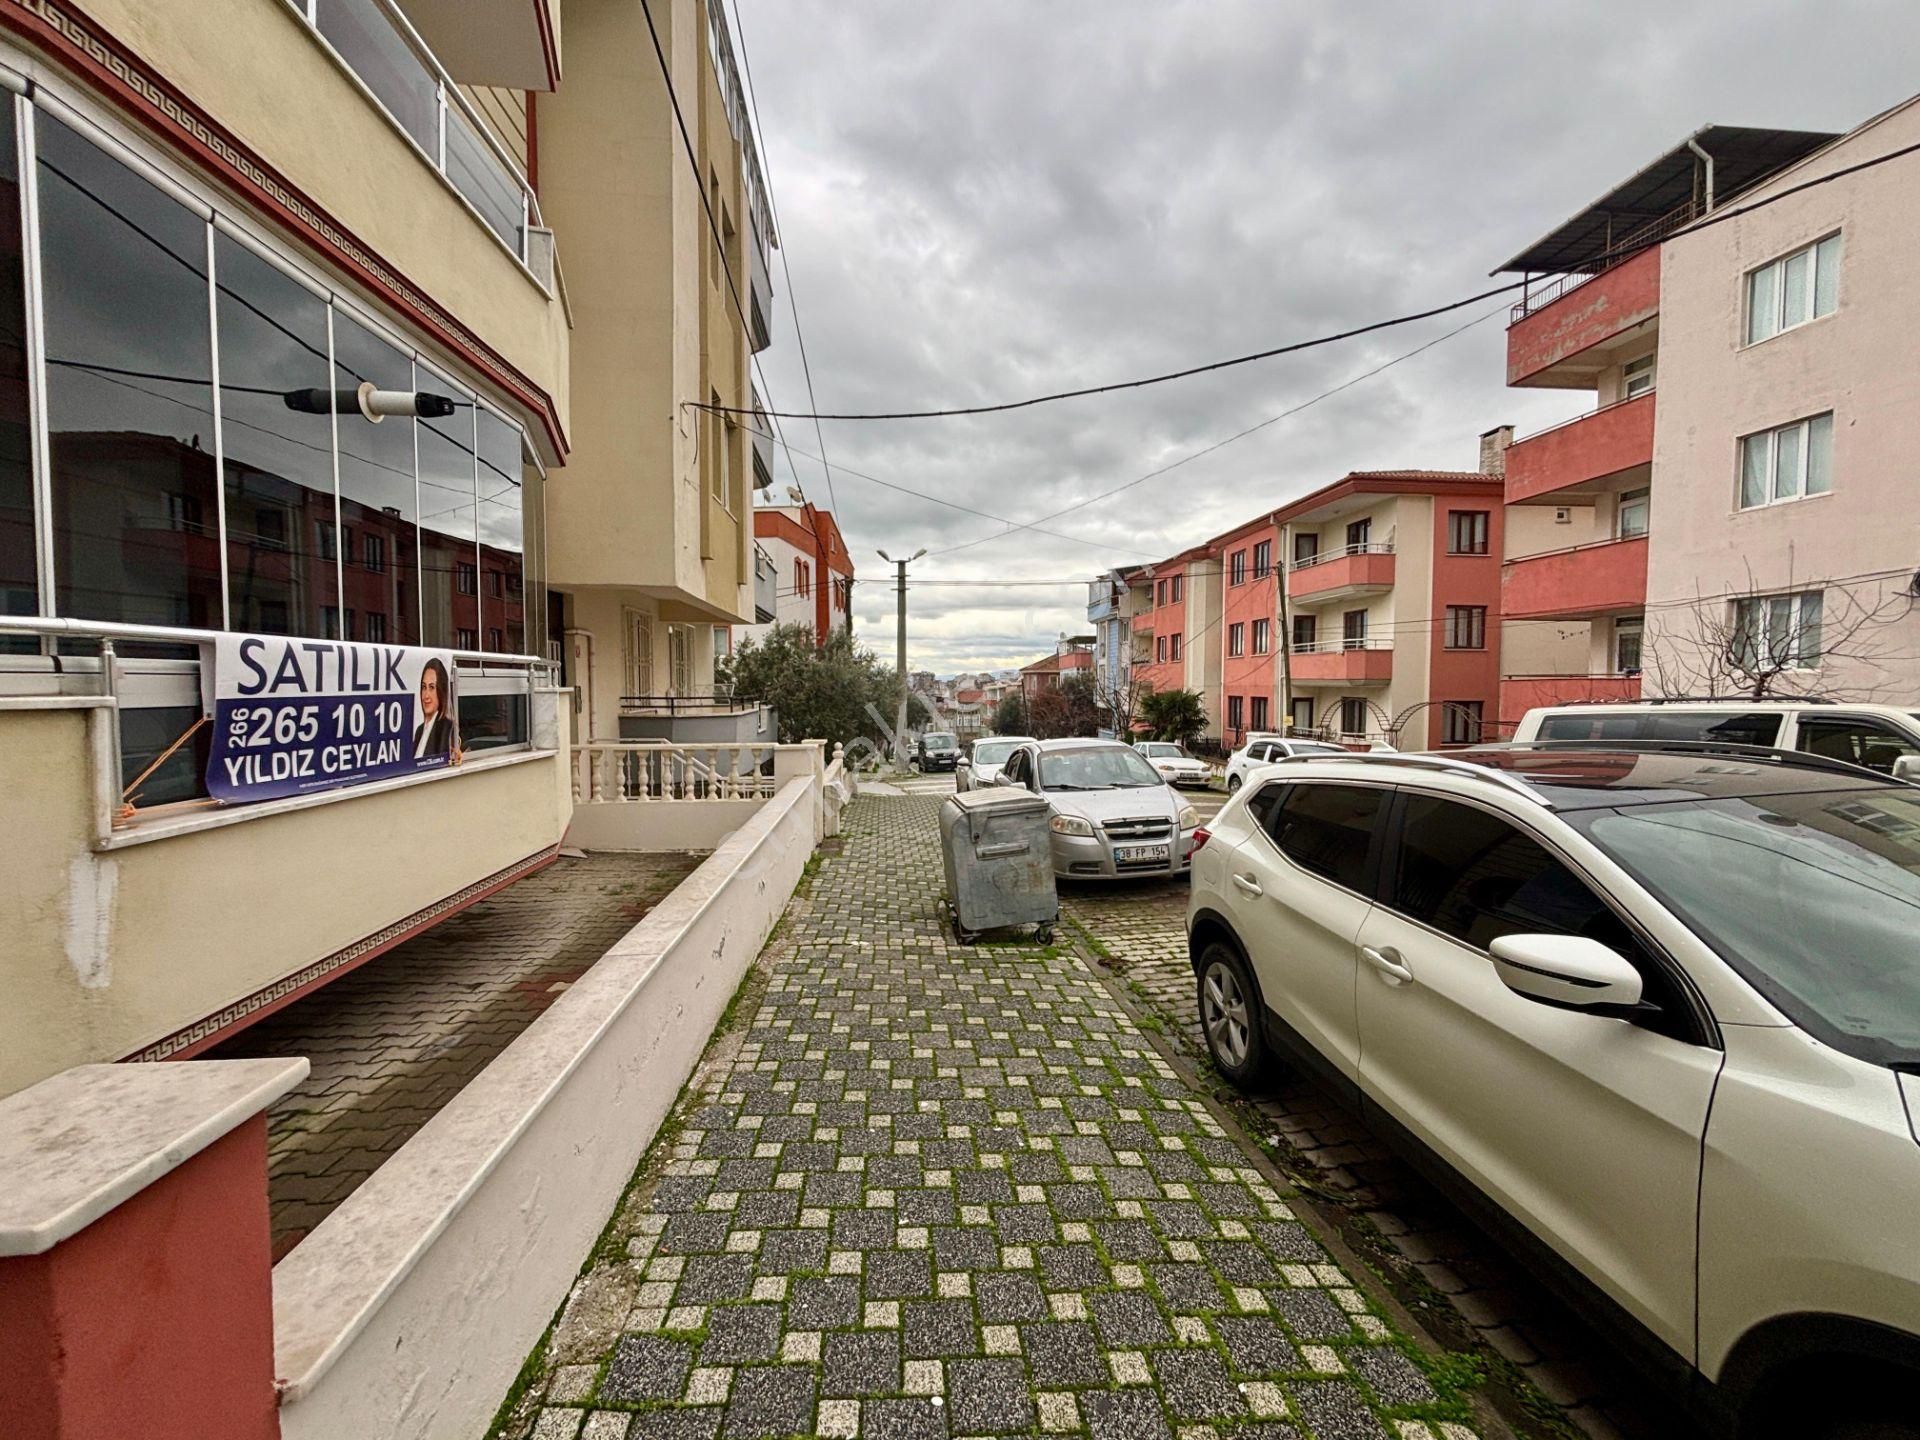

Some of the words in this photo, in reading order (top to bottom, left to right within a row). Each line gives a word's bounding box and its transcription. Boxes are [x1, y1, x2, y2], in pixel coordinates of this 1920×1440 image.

[237, 638, 408, 695] SATILIK
[229, 707, 250, 749] 266
[247, 704, 319, 747] 265
[332, 703, 365, 738] 10
[374, 701, 402, 734] 10
[224, 749, 315, 787] YILDIZ
[321, 738, 401, 774] CEYLAN
[1136, 848, 1146, 857] FP
[1152, 846, 1165, 856] 154
